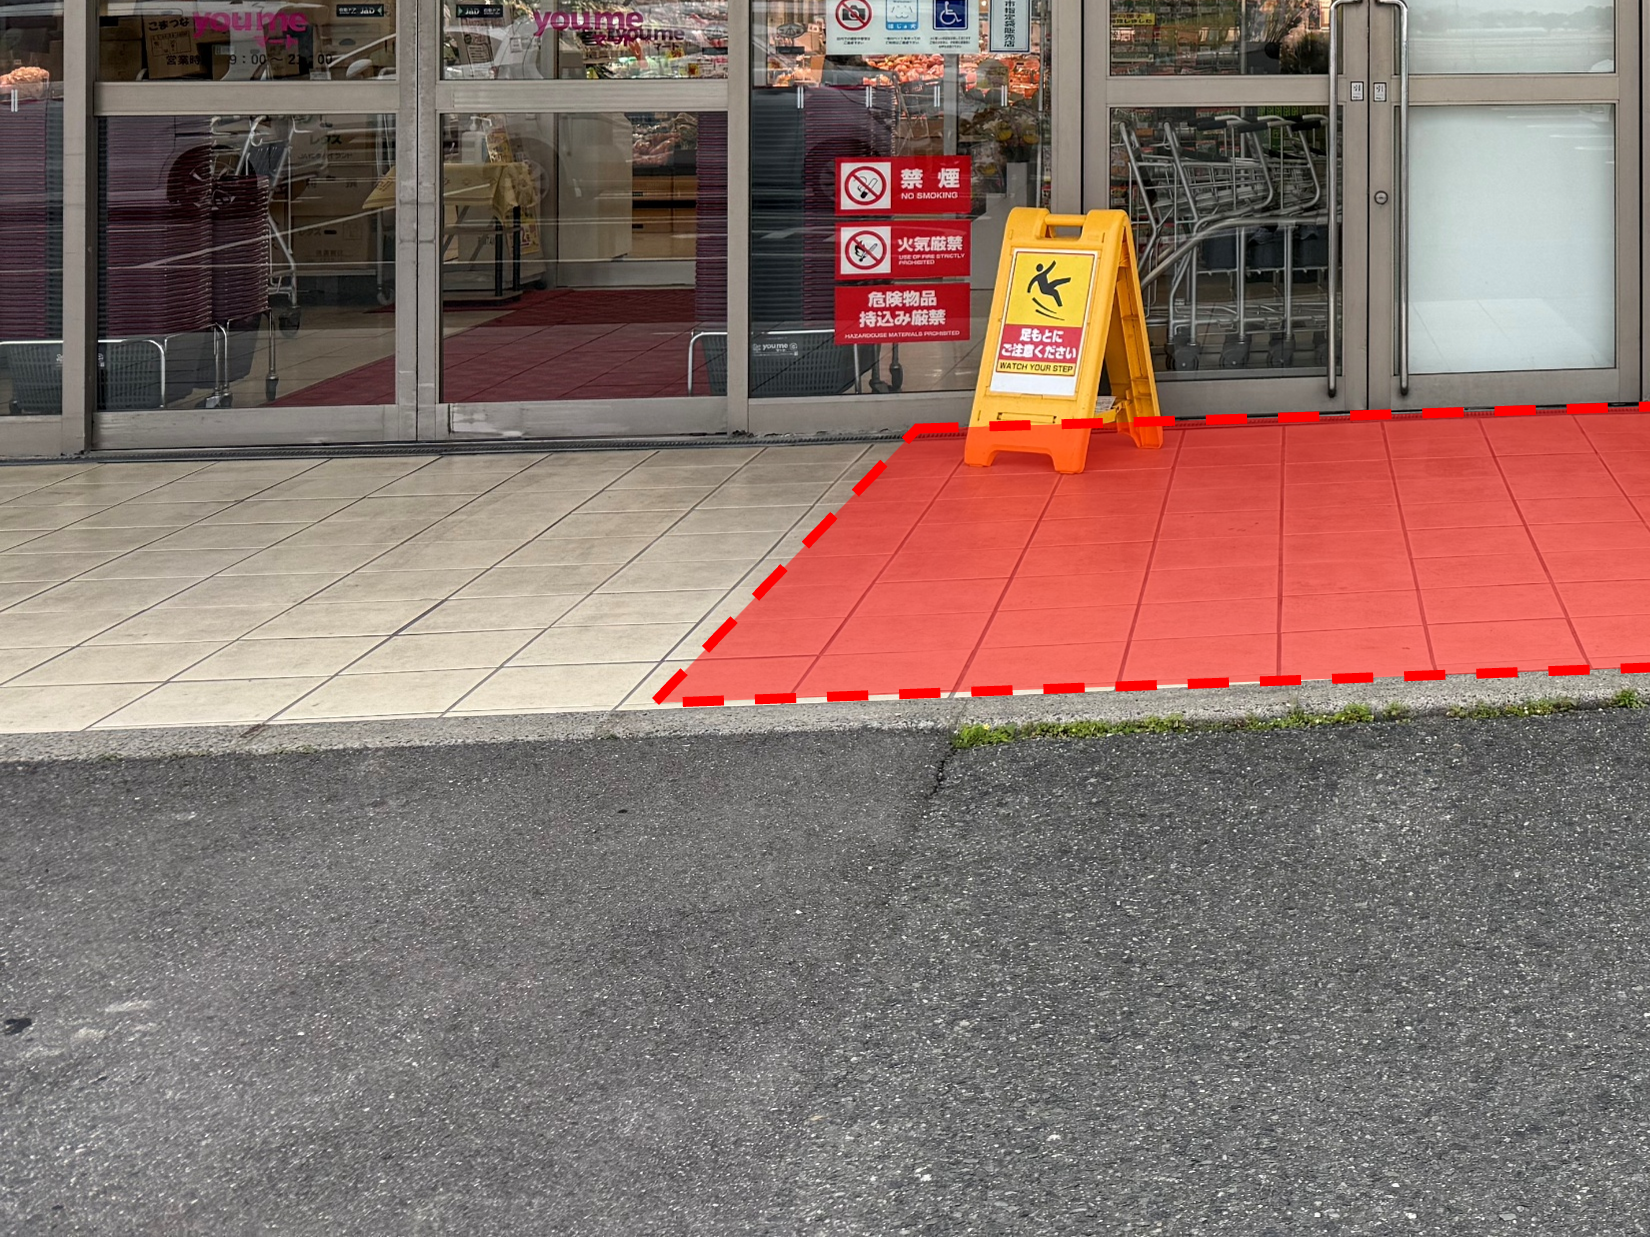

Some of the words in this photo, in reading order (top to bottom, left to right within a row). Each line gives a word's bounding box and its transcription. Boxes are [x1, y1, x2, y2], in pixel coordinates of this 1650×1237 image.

[148, 19, 190, 31] こまつな
[193, 11, 308, 39] youme
[533, 9, 644, 37] youme
[901, 192, 915, 200] NO
[917, 192, 959, 200] SMOKING
[897, 236, 963, 252] 火気厳禁
[868, 290, 937, 308] 危険物品
[859, 309, 946, 328] 持込み厳禁
[1019, 328, 1064, 343] 足もとに
[1001, 343, 1077, 360] ご注意ください
[999, 362, 1027, 371] WATCH
[1029, 363, 1051, 372] YOUR
[1052, 364, 1073, 373] STEP
